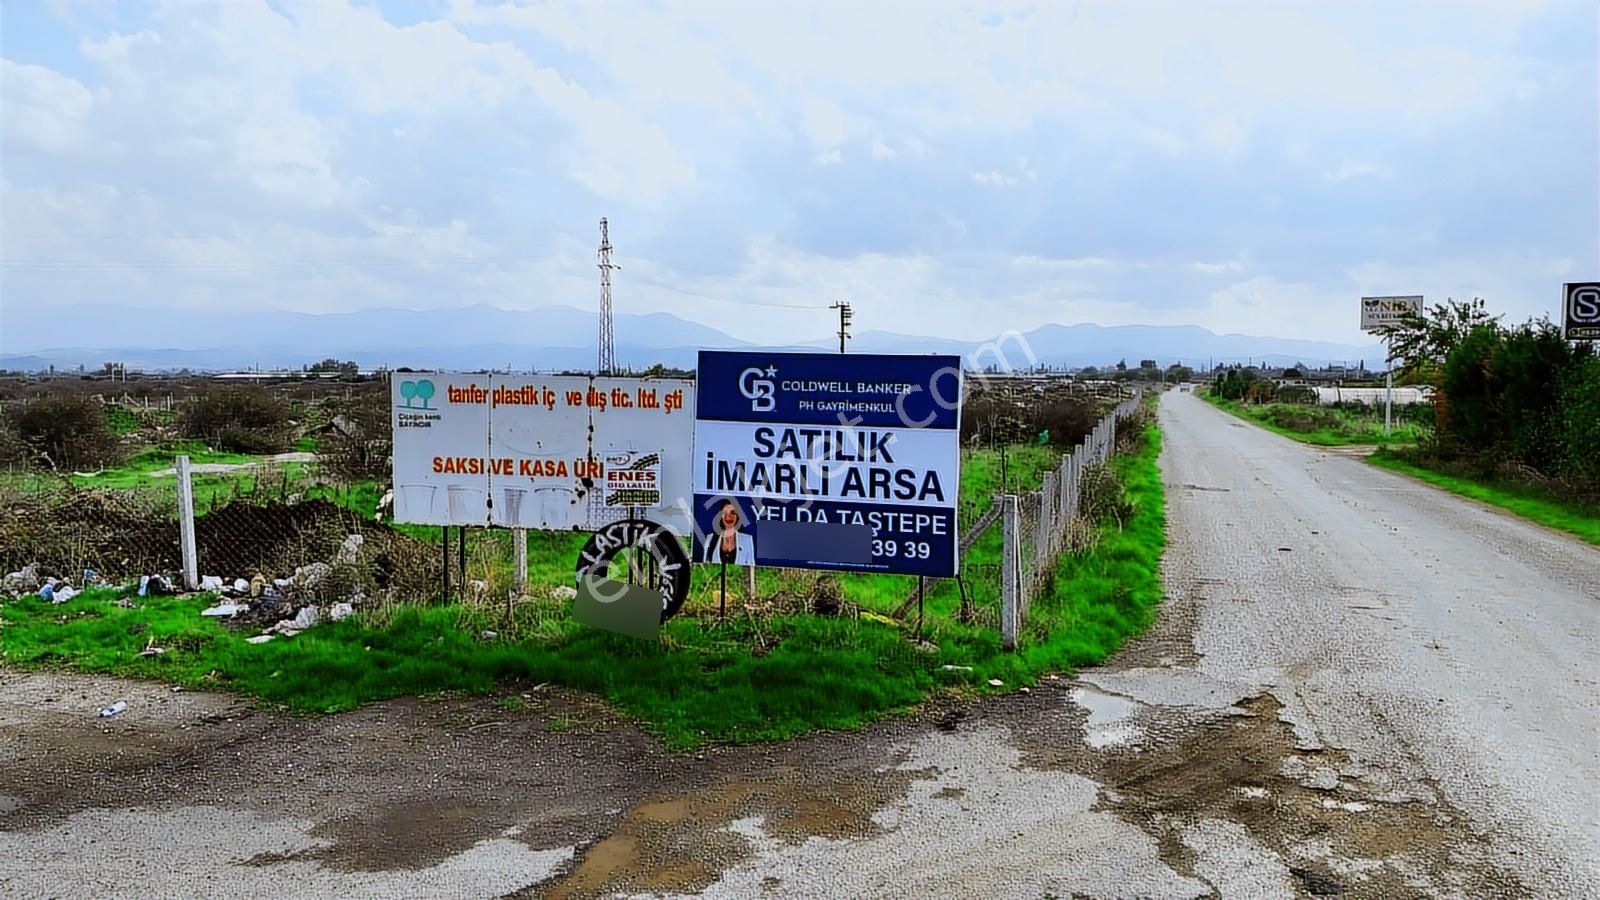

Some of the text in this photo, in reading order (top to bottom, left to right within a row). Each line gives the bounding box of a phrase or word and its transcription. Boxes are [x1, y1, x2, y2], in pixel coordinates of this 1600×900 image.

[447, 384, 488, 404] tanfer
[492, 385, 539, 408] plastik
[542, 388, 555, 411] iç
[566, 391, 582, 407] ve
[611, 388, 633, 408] tic.
[638, 388, 659, 409] ltd.
[781, 380, 911, 396] COLDWELL BANKER
[798, 398, 895, 413] PH GAYRİMENKUL
[753, 427, 895, 463] SATILIK
[433, 456, 484, 474] SAKSI
[490, 458, 513, 476] VE
[520, 459, 568, 477] KASA
[607, 472, 656, 481] ENES
[706, 452, 945, 502] İMARLI ARSA
[836, 510, 946, 537] TAŞTEPE
[904, 541, 930, 558] 39
